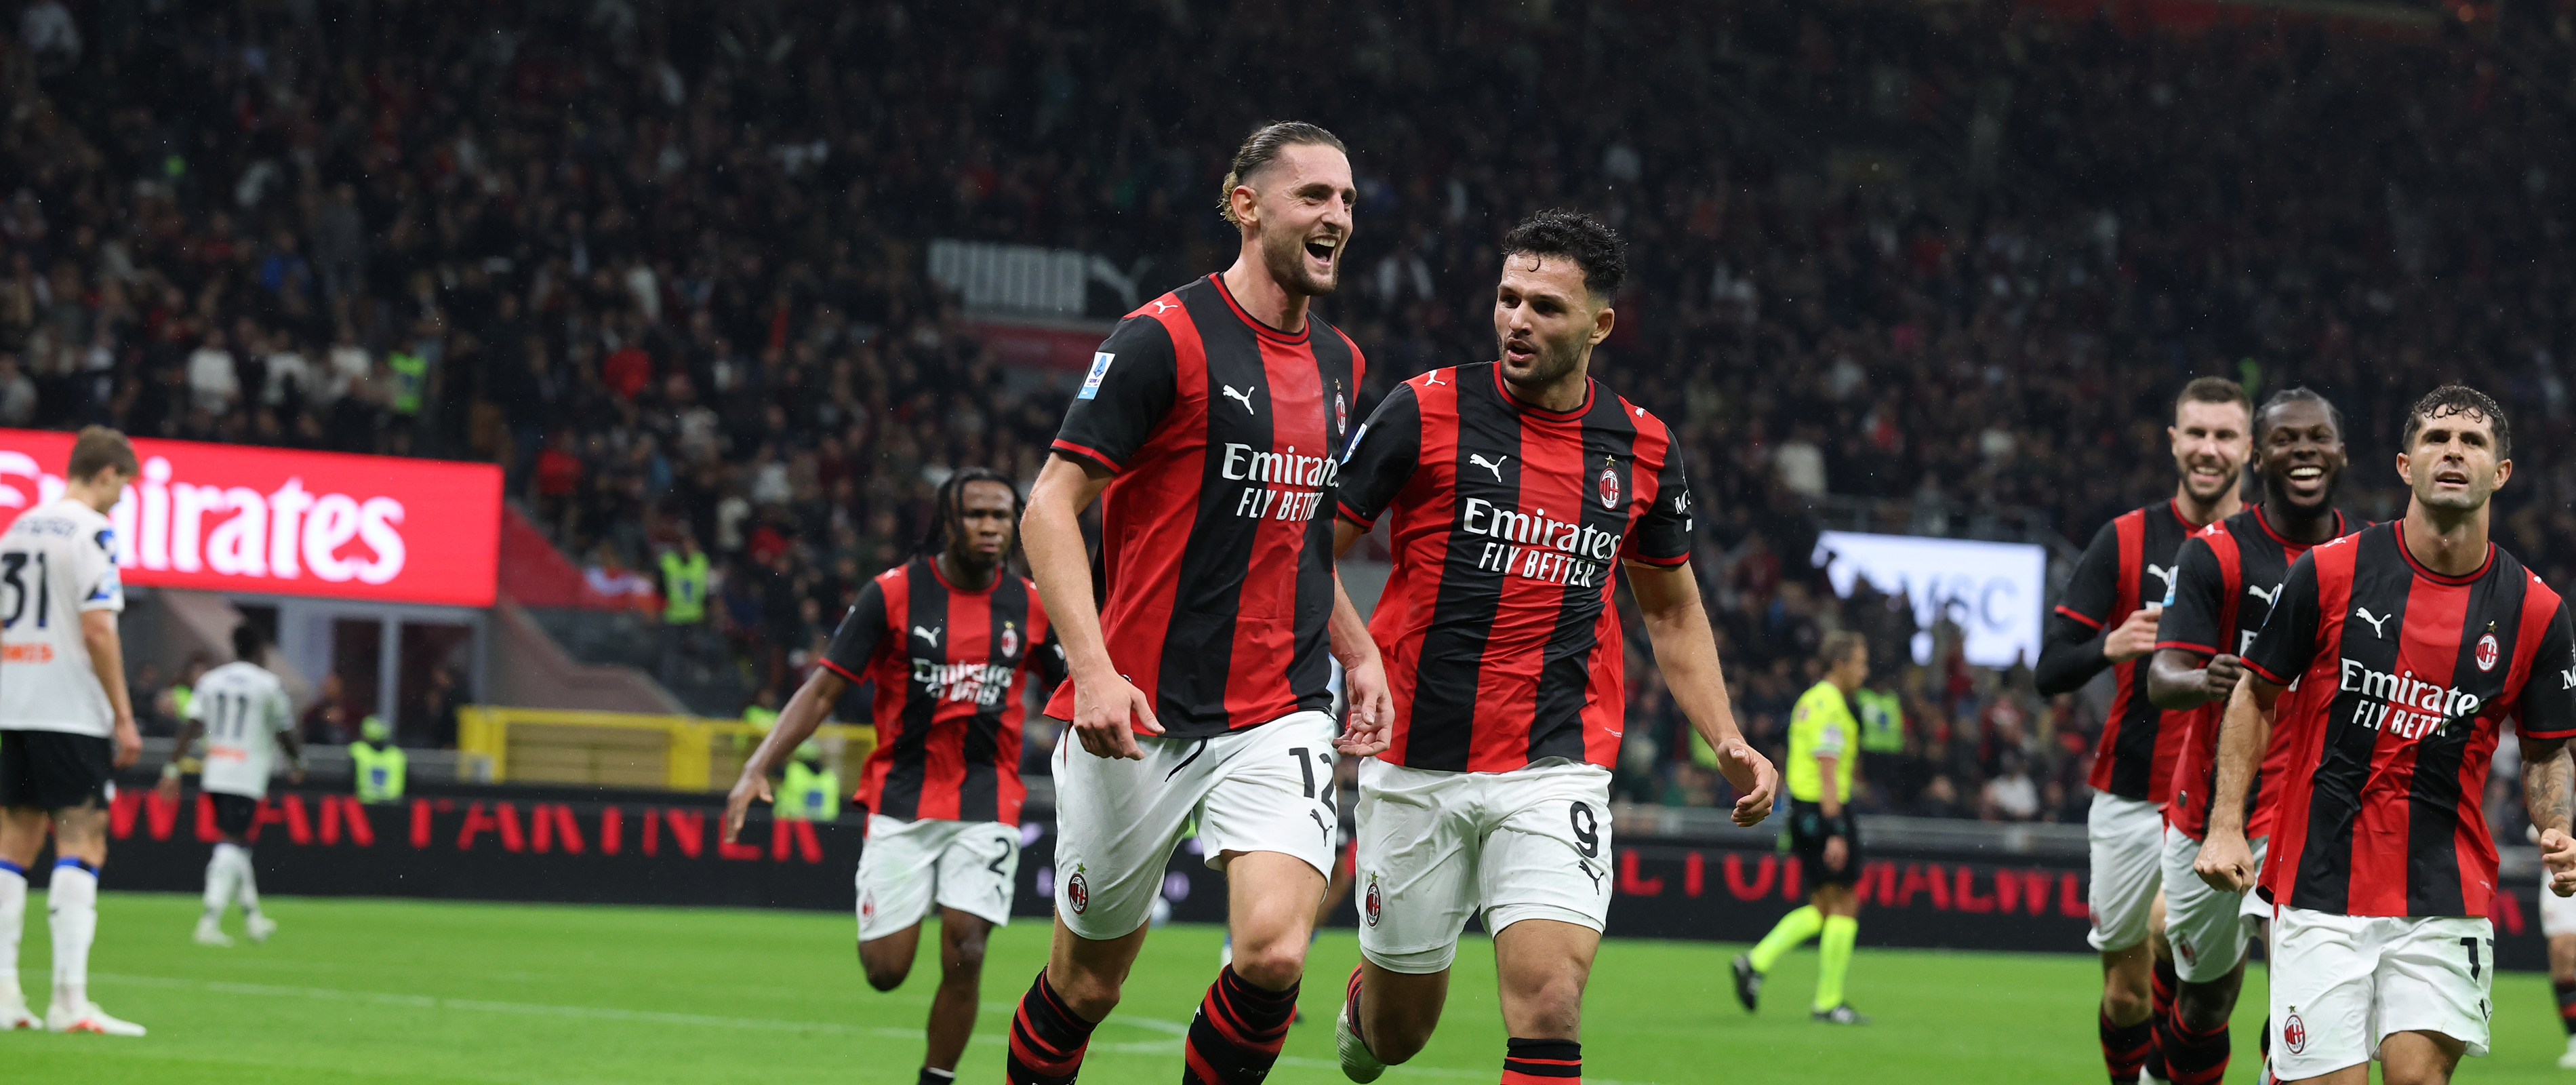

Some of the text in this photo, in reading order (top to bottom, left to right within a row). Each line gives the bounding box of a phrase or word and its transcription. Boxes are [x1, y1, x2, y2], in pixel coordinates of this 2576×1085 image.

[1222, 442, 1340, 488] Emirate
[1236, 487, 1277, 519] FLY
[1463, 497, 1622, 560] Emirates
[1, 551, 47, 629] 31
[1478, 542, 1596, 588] FLY BETTER
[2340, 657, 2481, 717] Emirate
[2352, 699, 2390, 731] FLY
[1289, 747, 1337, 818] 12
[1570, 801, 1599, 859] 9
[2459, 937, 2494, 983] 1
